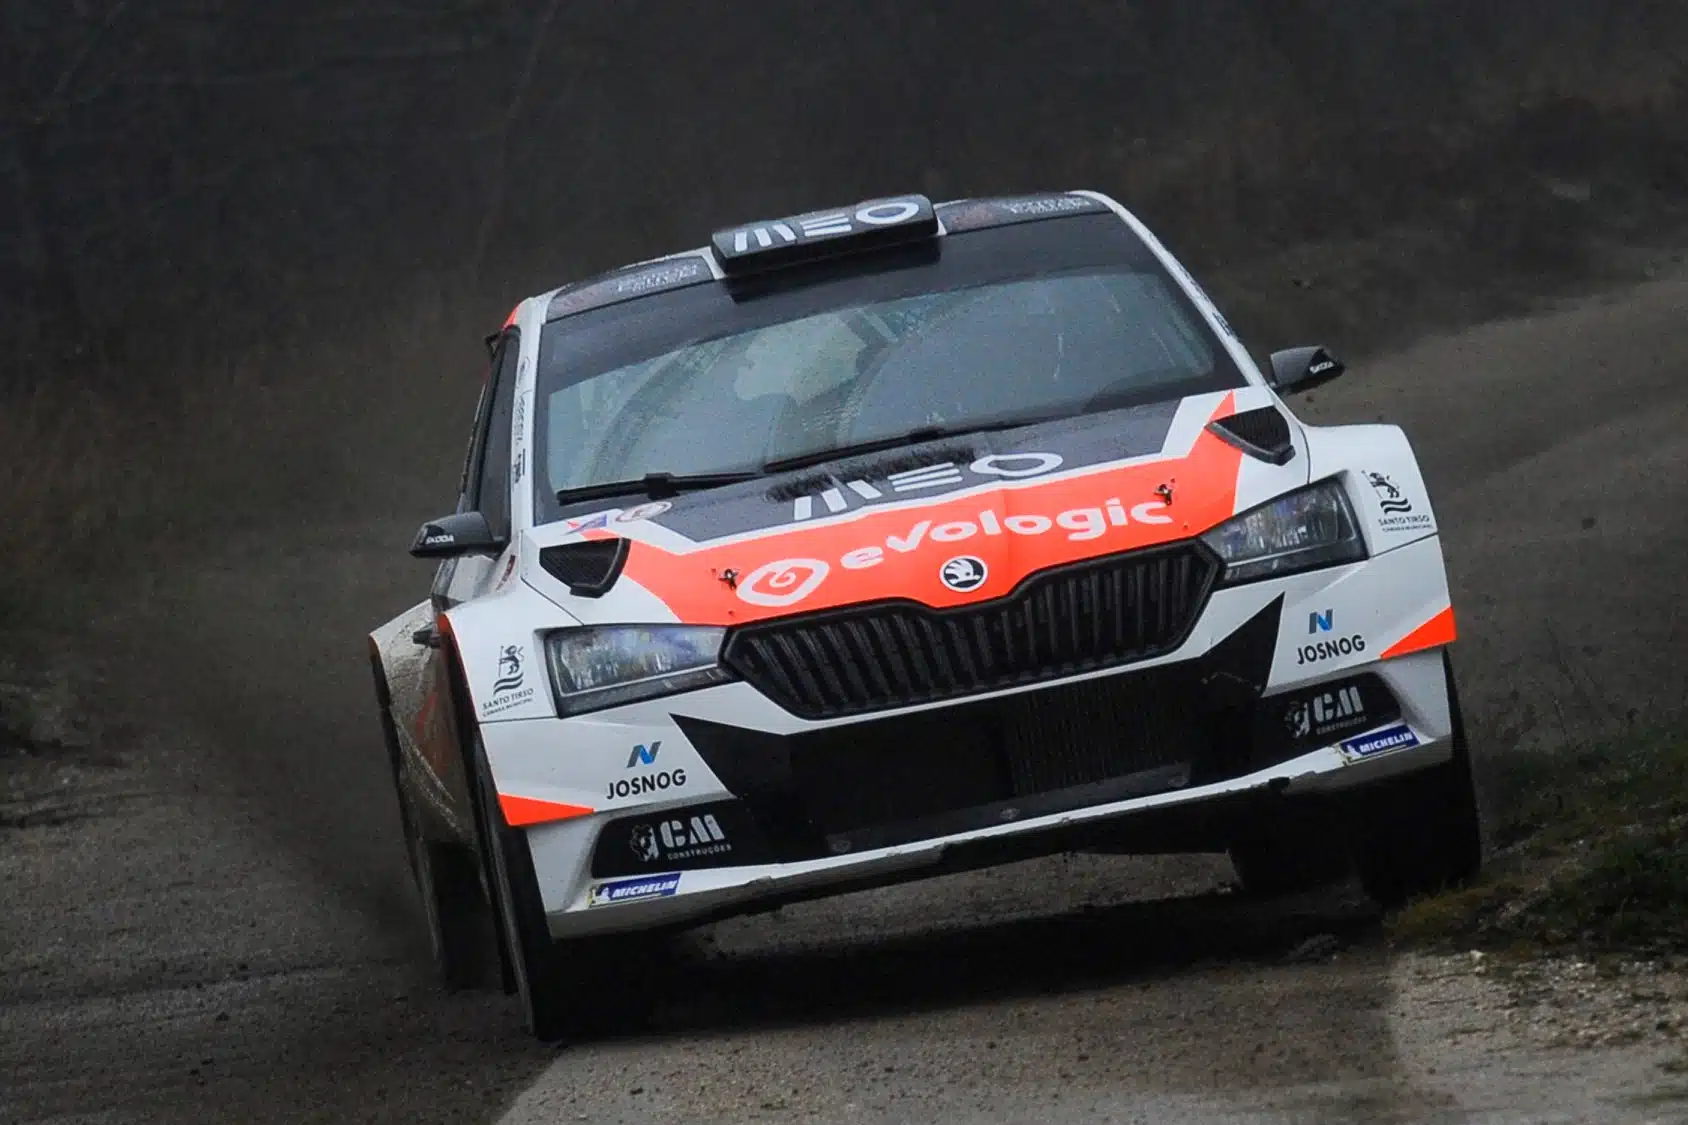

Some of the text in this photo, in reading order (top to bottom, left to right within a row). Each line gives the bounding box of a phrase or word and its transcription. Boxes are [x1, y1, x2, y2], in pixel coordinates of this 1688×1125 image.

[734, 202, 919, 252] MEO
[794, 453, 1062, 520] MEO
[841, 497, 1174, 569] evologic
[1297, 634, 1366, 665] JOSNOG
[482, 695, 510, 710] SANTO
[1359, 732, 1413, 753] MICHELIN
[607, 769, 687, 800] JOSNOG
[612, 880, 679, 898] MICHELIN
